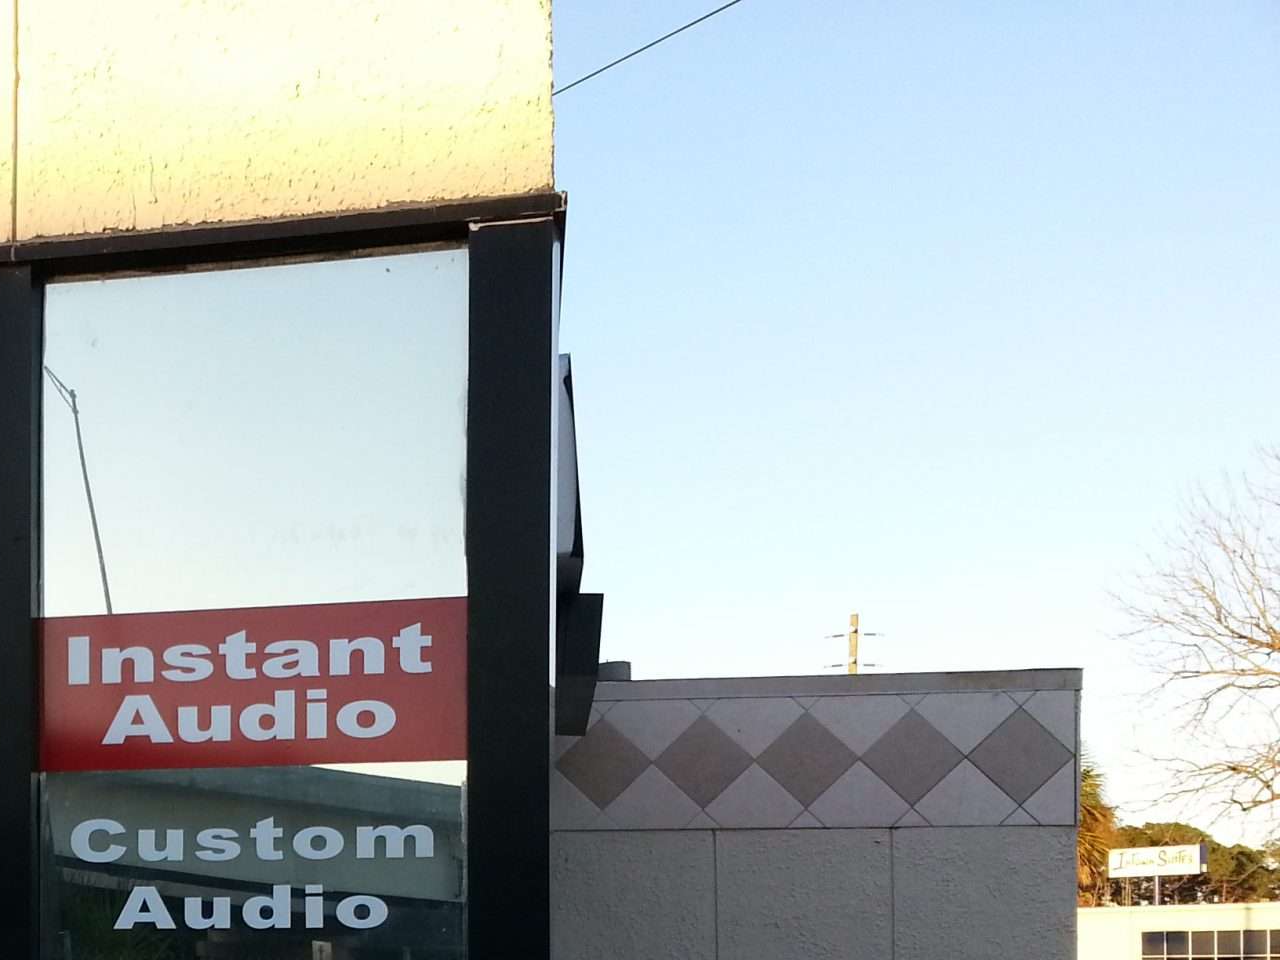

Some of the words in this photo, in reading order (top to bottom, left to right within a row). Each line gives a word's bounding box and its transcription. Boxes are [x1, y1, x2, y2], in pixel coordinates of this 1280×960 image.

[67, 621, 434, 686] Instant
[101, 688, 398, 746] Audio
[70, 816, 435, 863] Custom
[113, 884, 389, 930] Audio
